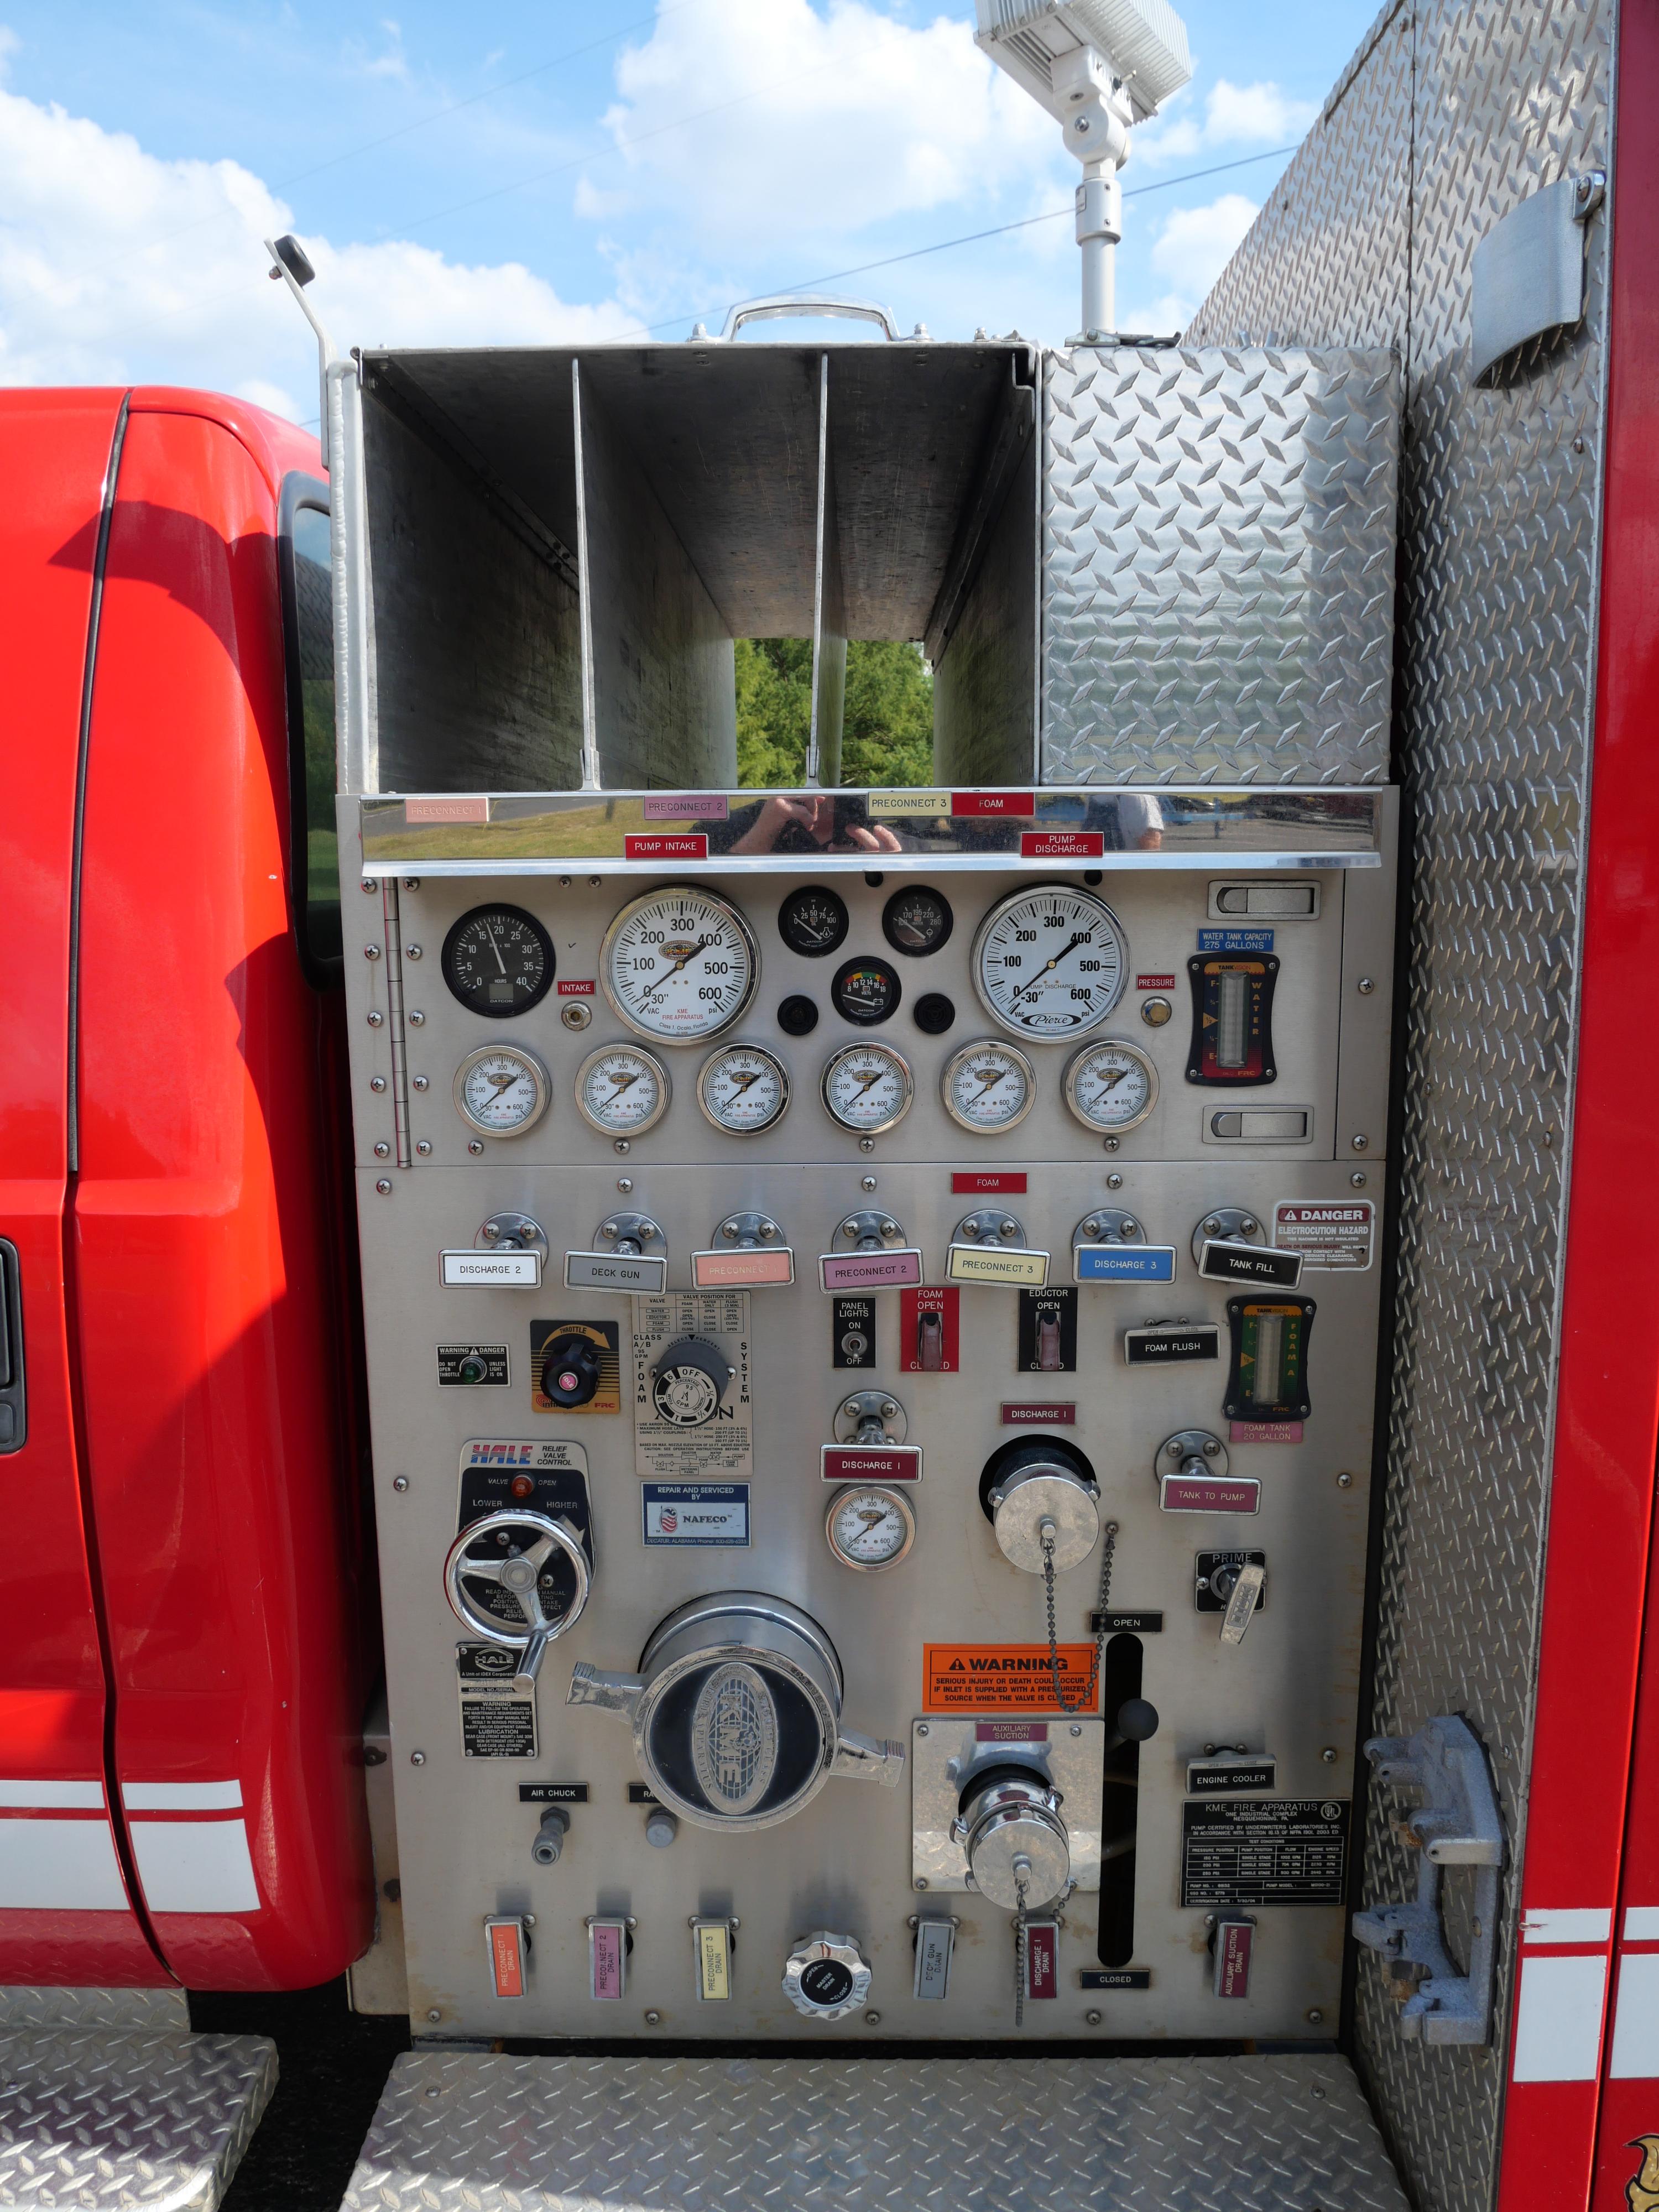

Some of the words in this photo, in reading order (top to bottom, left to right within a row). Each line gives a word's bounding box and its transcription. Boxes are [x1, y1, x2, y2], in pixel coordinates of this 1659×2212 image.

[648, 803, 712, 812] PRECONNECT
[717, 802, 723, 811] 2
[872, 799, 936, 807] PRECONNECT
[979, 800, 1003, 808] FOAM
[1049, 835, 1075, 844] PUMP
[635, 842, 661, 851] PUMP
[665, 842, 697, 851] INTAKE
[1035, 845, 1088, 853] DISCHARGE
[670, 919, 694, 931] 300
[1044, 916, 1065, 927] 300
[494, 926, 504, 934] 20
[1016, 930, 1036, 942] 200
[468, 945, 476, 953] 10
[633, 958, 655, 970] 100
[1080, 961, 1100, 972] 500
[516, 977, 526, 985] 40
[698, 987, 722, 999] 600
[1035, 1015, 1067, 1025] Pierce
[1301, 1211, 1363, 1220] DANGER
[1339, 1226, 1368, 1234] HAZARD
[962, 1260, 1024, 1272] PRECONNECT
[1095, 1260, 1145, 1269] DISCHARGE
[1229, 1259, 1252, 1270] TANK
[1256, 1263, 1275, 1272] FILL
[592, 1268, 616, 1278] DECK
[620, 1270, 640, 1279] GUN
[835, 1266, 896, 1277] PRECONNECT
[682, 1369, 700, 1377] OFF
[471, 1445, 533, 1464] HALE
[842, 1461, 893, 1469] DISCHARGE
[1178, 1491, 1201, 1499] TANK
[1213, 1553, 1252, 1563] PRIME
[969, 1658, 1068, 1671] WARNING
[1228, 1929, 1238, 1959] SUCTION
[498, 1940, 508, 1986] PRECONNECT
[507, 1950, 515, 1970] DRAIN
[599, 1942, 607, 1990] PRECONNECT
[707, 1944, 715, 1991] PRECONNECT
[816, 1973, 832, 1989] MASTER
[1225, 1962, 1234, 1995] AUXILIARY
[823, 1978, 835, 1991] DRAIN
